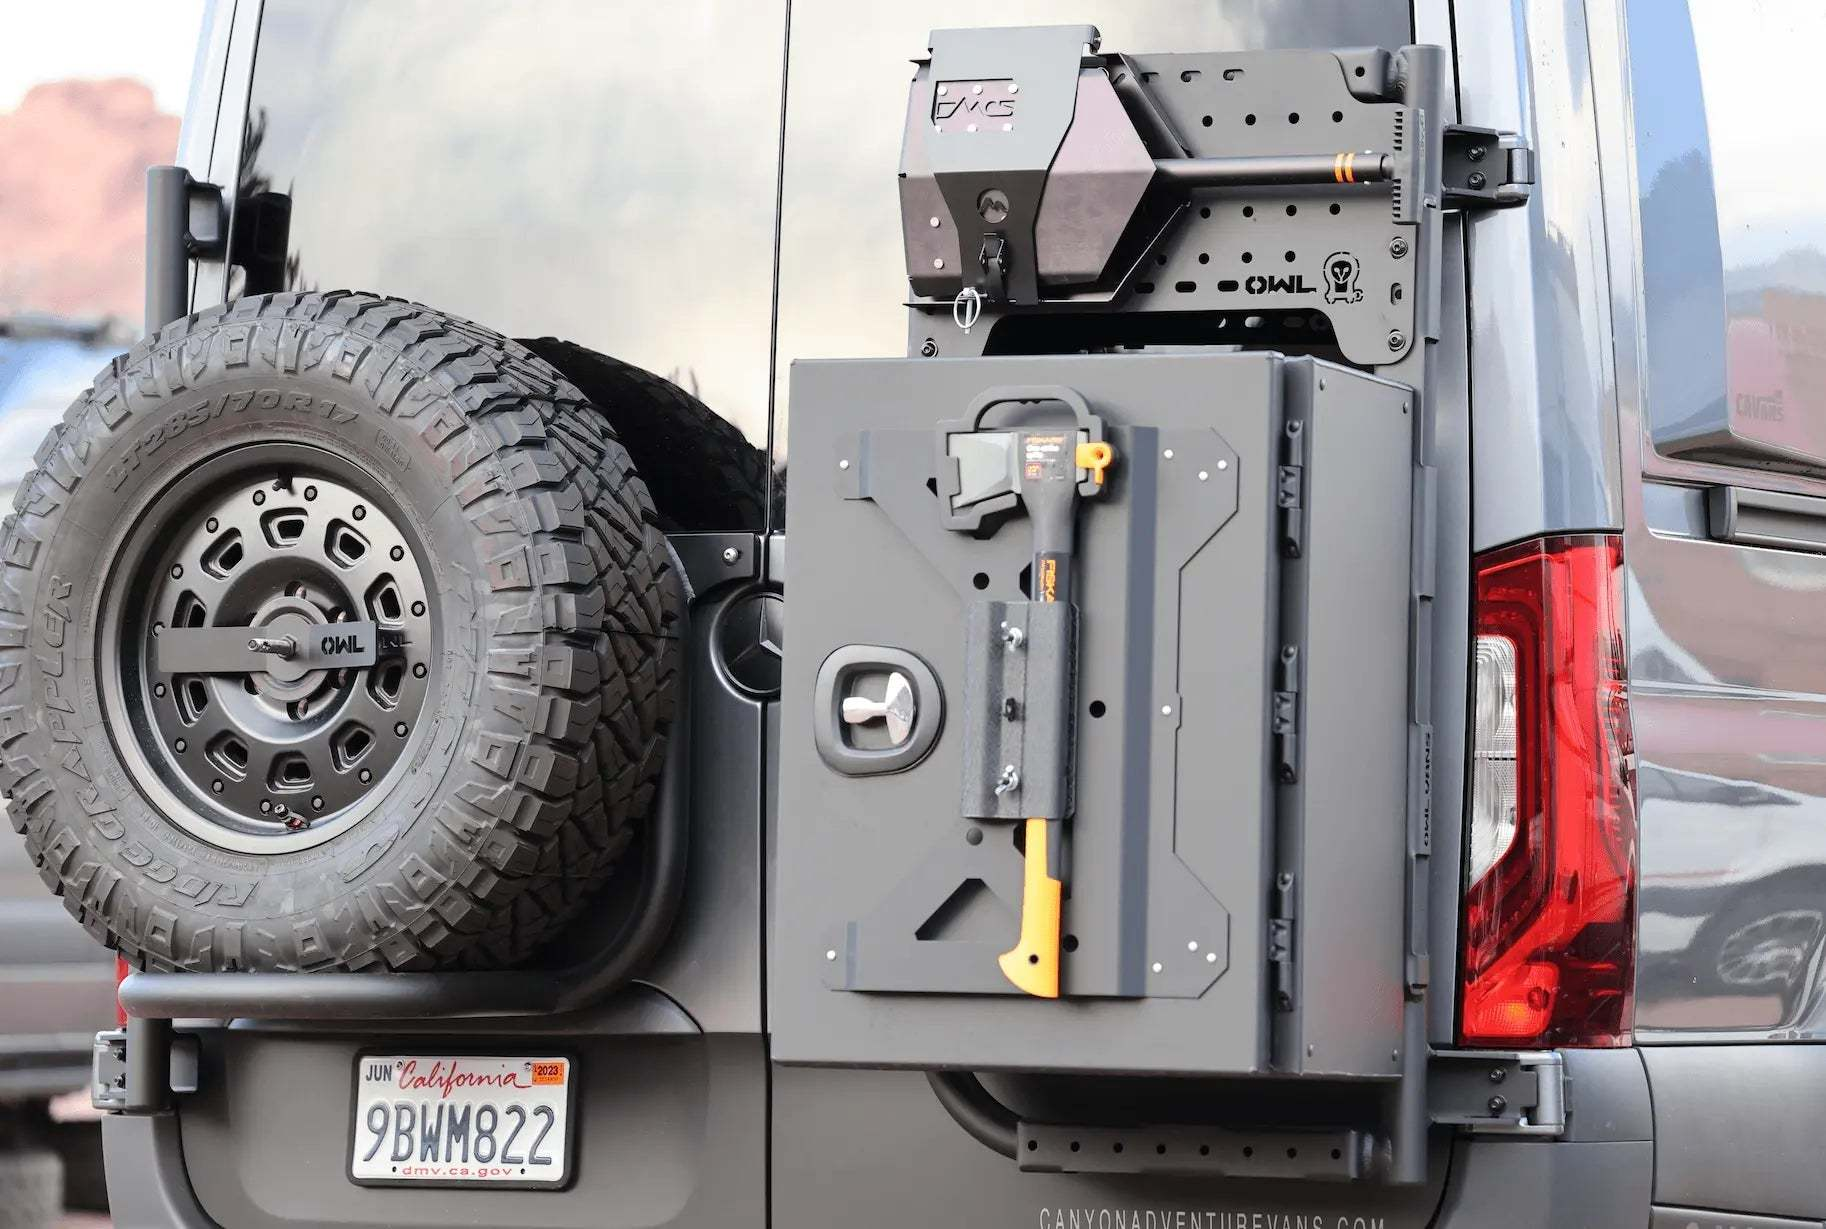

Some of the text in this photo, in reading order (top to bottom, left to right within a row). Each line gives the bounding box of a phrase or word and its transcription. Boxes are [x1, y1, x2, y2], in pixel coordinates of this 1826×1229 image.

[1245, 274, 1317, 295] OWL
[1045, 559, 1056, 602] FISKA
[321, 634, 365, 655] OWL
[366, 1059, 559, 1099] JUN California 2023
[362, 1103, 556, 1166] 9BWM822
[402, 1165, 513, 1178] dmv.ca.gov
[1039, 1207, 1384, 1229] CANYONADVENTUREVANSCO
